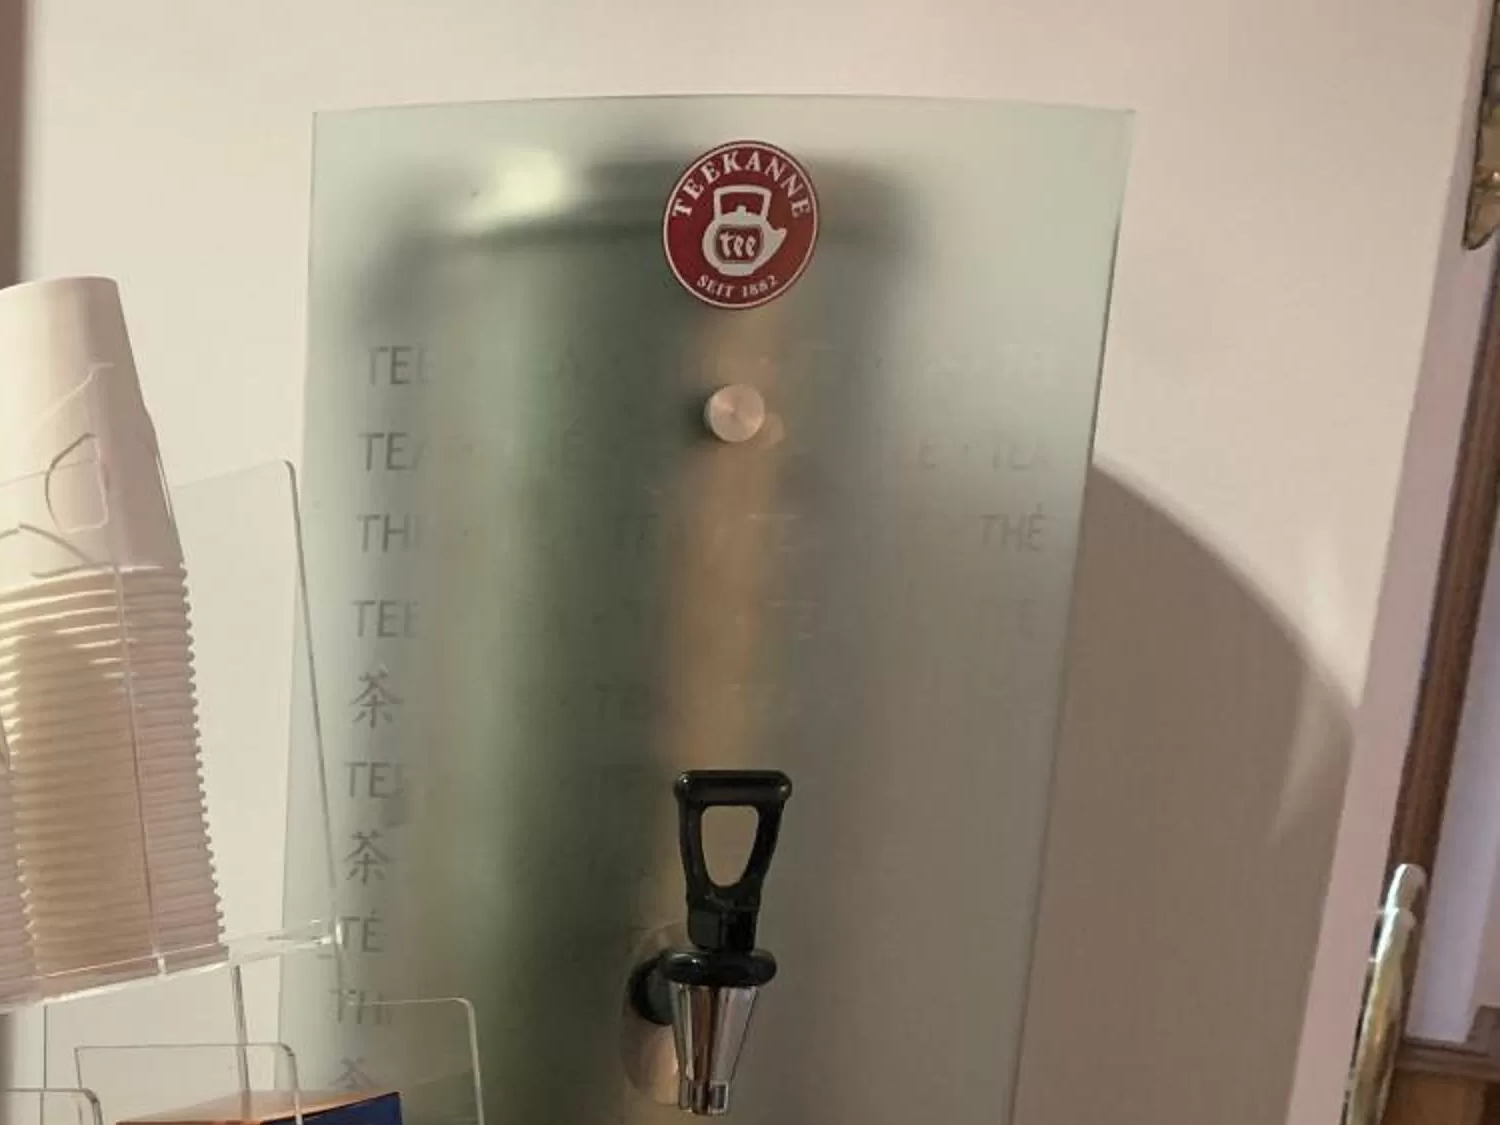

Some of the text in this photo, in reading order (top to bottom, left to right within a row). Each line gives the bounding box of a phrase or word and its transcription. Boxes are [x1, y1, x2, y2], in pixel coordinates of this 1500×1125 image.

[672, 151, 812, 219] TEEKANNE
[719, 230, 757, 258] tee
[696, 274, 780, 299] SEIT 1882
[347, 670, 406, 730] 茶
[342, 829, 397, 885] 茶
